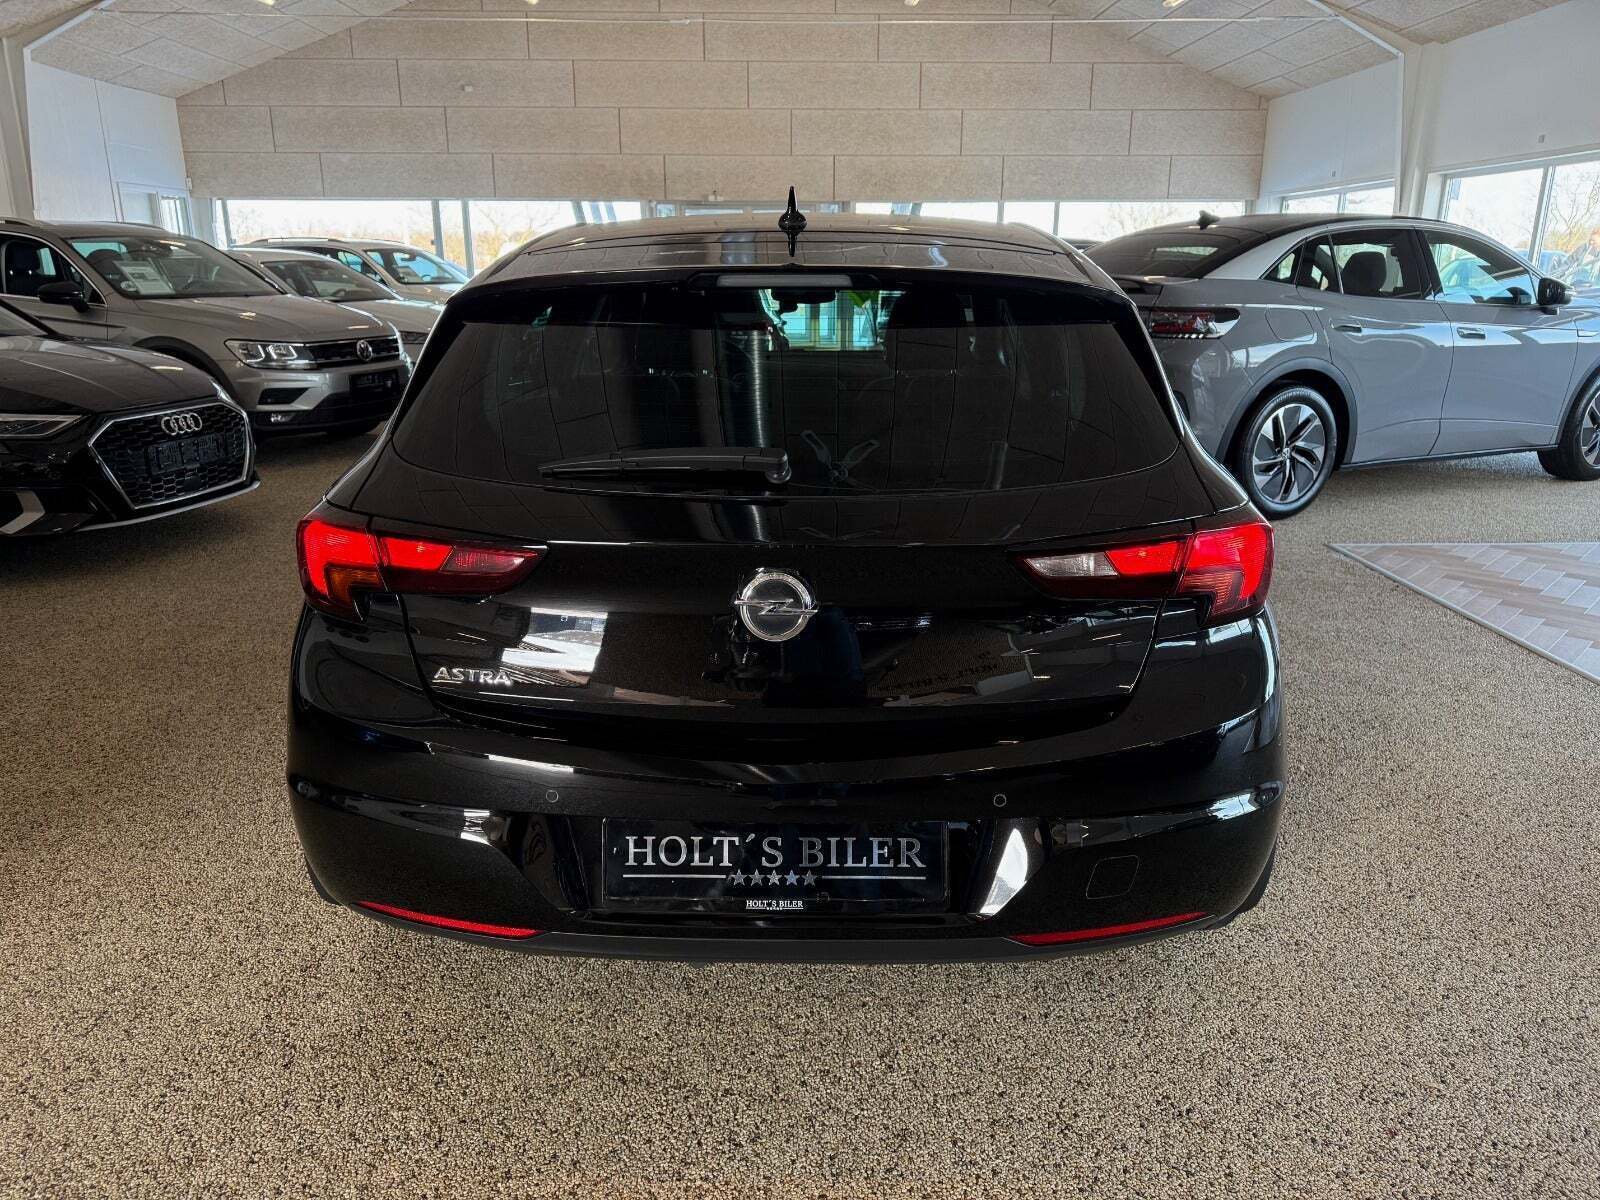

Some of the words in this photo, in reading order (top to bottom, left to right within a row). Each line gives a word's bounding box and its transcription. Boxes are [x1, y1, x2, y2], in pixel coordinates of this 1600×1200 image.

[433, 667, 512, 686] ASTRA
[798, 837, 927, 869] BILER
[779, 900, 803, 908] BILER
